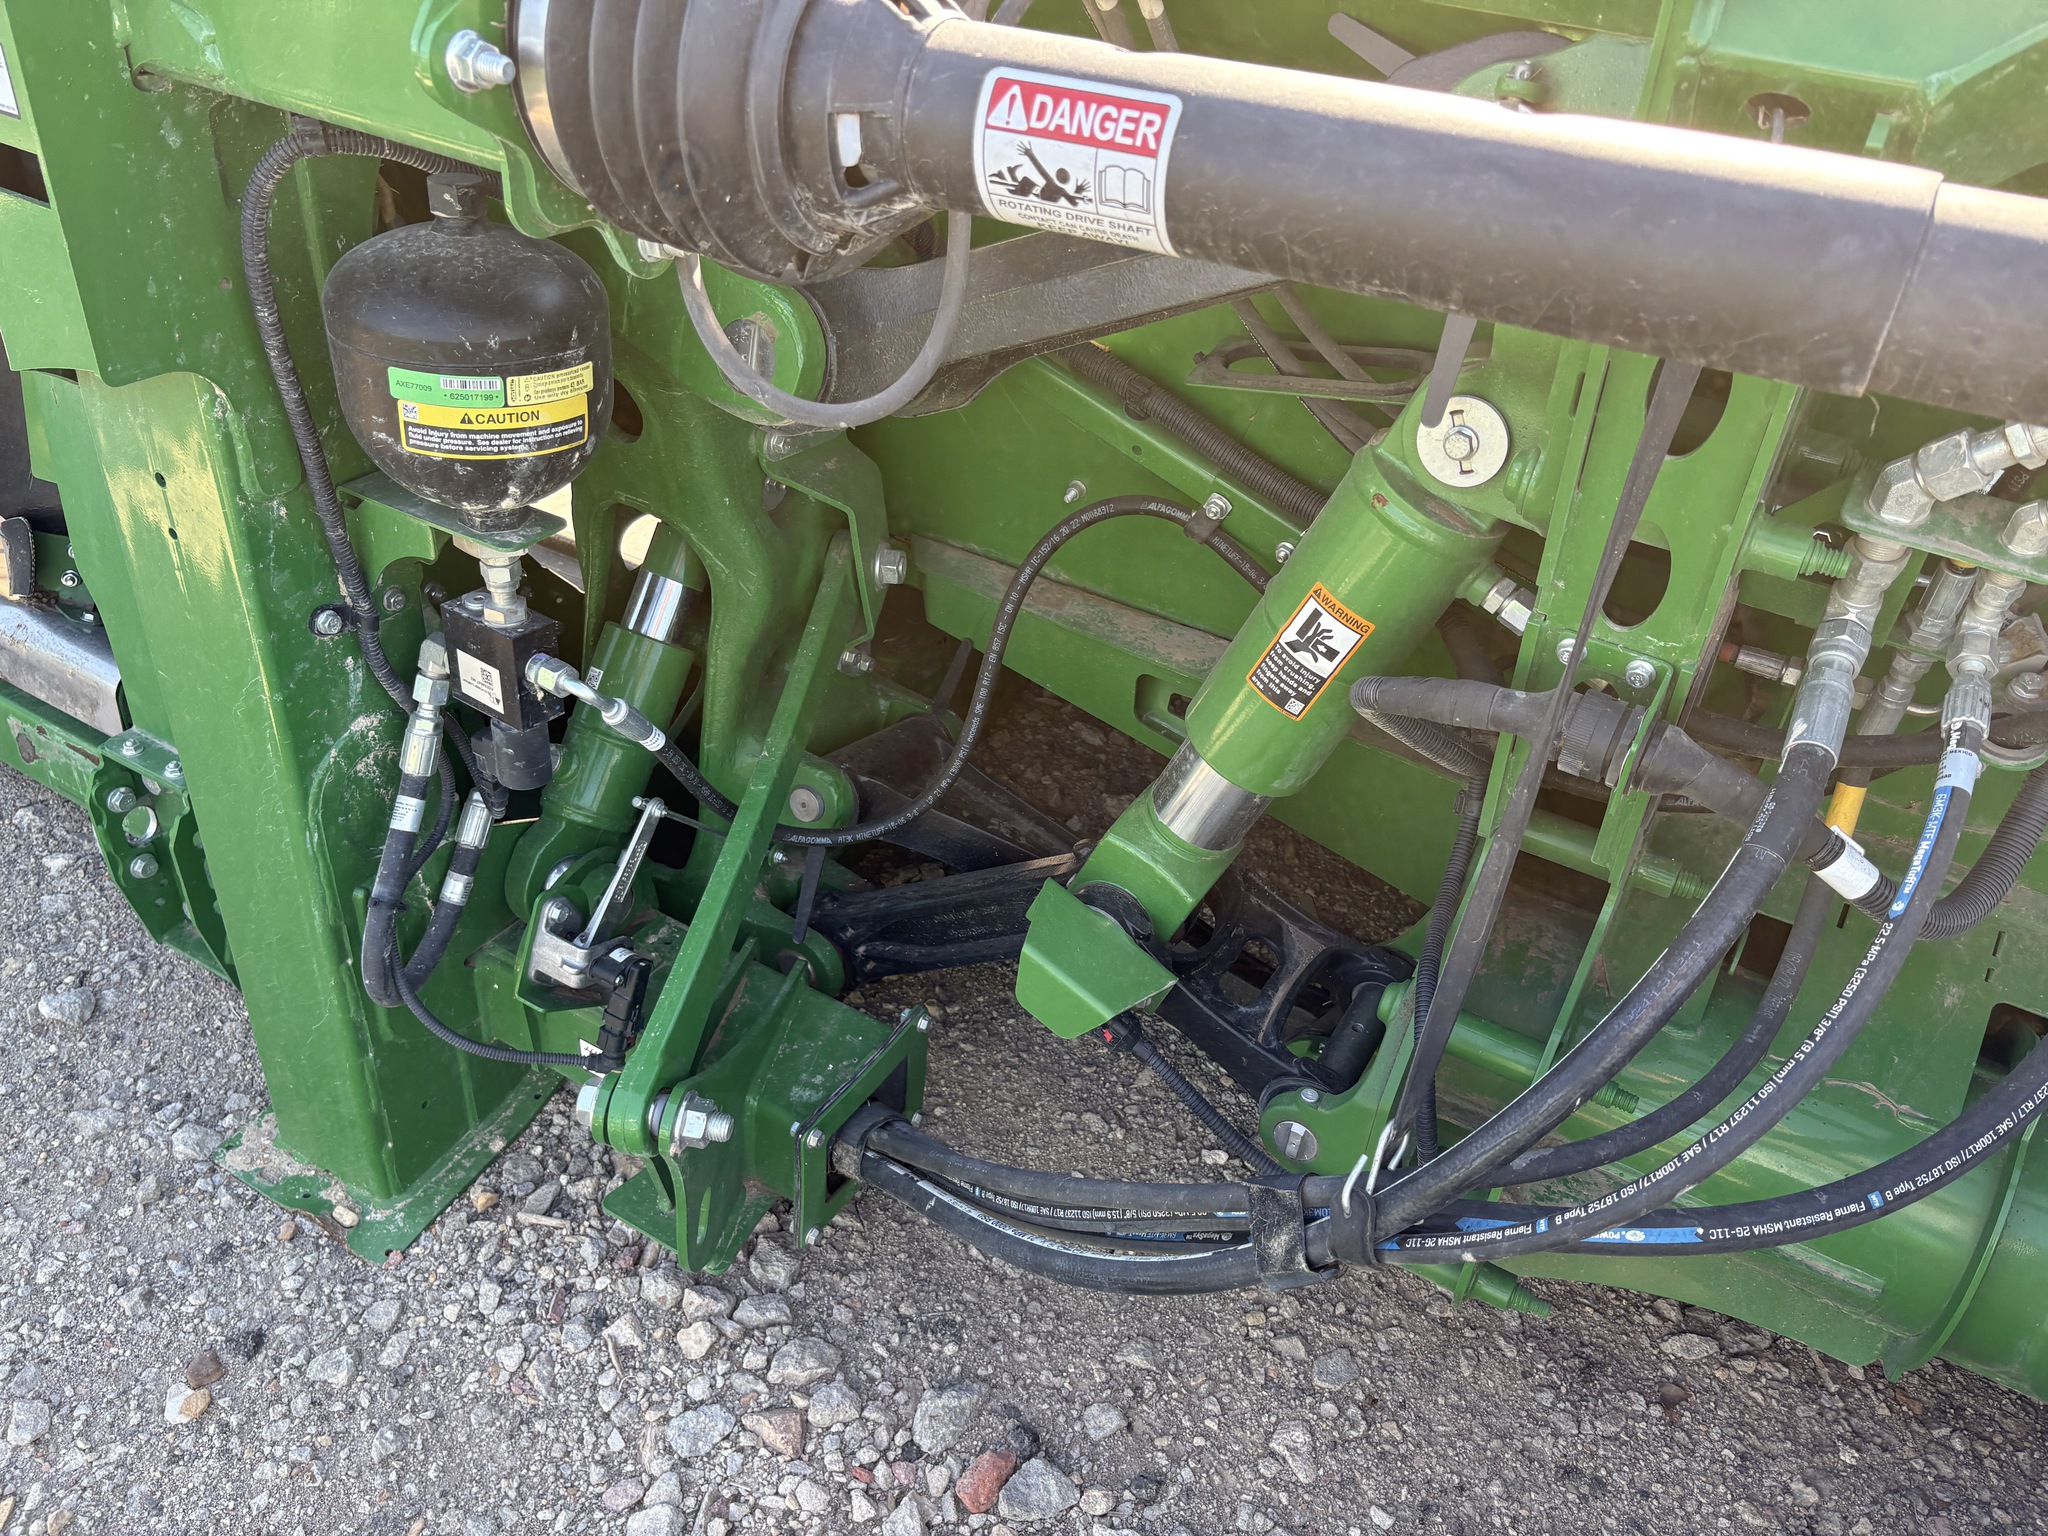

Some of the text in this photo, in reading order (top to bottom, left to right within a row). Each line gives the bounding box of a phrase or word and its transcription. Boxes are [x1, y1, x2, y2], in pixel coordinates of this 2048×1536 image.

[1030, 93, 1162, 150] DANGER
[998, 199, 1152, 237] ROTATING DRIVE SHAFT
[1018, 212, 1139, 242] CONTACT CAN CAUSE DEATH
[1036, 223, 1130, 245] KEEP AWAY!
[395, 380, 433, 392] AXE77009
[450, 393, 494, 401] 625017199
[475, 410, 540, 425] CAUTION
[408, 425, 427, 435] Avoid
[501, 430, 537, 439] movement
[551, 421, 576, 434] exposure
[408, 432, 422, 440] fluid
[423, 434, 442, 444] under
[443, 437, 474, 446] pressure.
[562, 425, 583, 437] relieving
[409, 438, 439, 449] pressure
[440, 443, 463, 452] before
[465, 444, 498, 453] servicing
[1019, 566, 1033, 584] MSHA
[1010, 592, 1019, 601] 10
[1005, 603, 1014, 614] DN
[1320, 594, 1370, 634] WARNING
[992, 638, 1002, 652] 857
[989, 653, 997, 663] EN
[1270, 650, 1283, 666] from
[1275, 644, 1321, 684] To avoid injury
[1251, 675, 1264, 691] area.
[1256, 669, 1281, 695] from this
[1260, 663, 1298, 697] fingers away
[1265, 656, 1313, 696] keep hands and
[979, 687, 989, 700] 100
[975, 702, 984, 714] SAE
[968, 717, 980, 742] exceeds
[950, 760, 962, 776] (3000
[941, 778, 952, 789] MPa
[1924, 792, 1947, 839] 6M3K-MTF
[789, 834, 832, 844] ALFAGOMMA
[1874, 922, 1894, 945] 22.5
[1861, 945, 1881, 966] MPa
[1842, 967, 1868, 998] (3250
[1825, 997, 1848, 1020] PSI)
[1813, 1017, 1832, 1042] 3/8"
[1796, 1039, 1815, 1064] (9.5
[1774, 1058, 1797, 1086] mm)
[1758, 1081, 1777, 1099] ISO
[1729, 1096, 1760, 1127] 11237
[2019, 1101, 2035, 1119] R17
[1710, 1123, 1730, 1143] R17
[1996, 1118, 2014, 1136] SAE
[1681, 1146, 1702, 1163] SAE
[1945, 1155, 1961, 1171] ISO
[1916, 1164, 1945, 1187] 18752
[960, 1180, 974, 1194] Flame
[981, 1190, 986, 1198] B
[1620, 1184, 1638, 1198] ISO
[1894, 1181, 1916, 1196] Type
[986, 1192, 998, 1204] Type
[996, 1195, 1010, 1208] 18752
[1587, 1193, 1619, 1213] 18752
[1885, 1190, 1893, 1201] B
[1010, 1200, 1019, 1210] ISO
[1038, 1205, 1050, 1217] SAE
[1563, 1205, 1587, 1221] Type
[1834, 1201, 1866, 1217] Flame
[1052, 1209, 1064, 1218] R17
[1064, 1209, 1081, 1219] 11237
[1081, 1209, 1092, 1219] ISO
[1092, 1210, 1106, 1219] mm)
[1106, 1210, 1123, 1220] (15.9
[1123, 1209, 1138, 1219] 5/8"
[1555, 1215, 1563, 1225] B
[1785, 1210, 1833, 1230] Resistant
[1503, 1223, 1533, 1237] Flame
[1709, 1225, 1750, 1240] 2G-11C
[1752, 1221, 1783, 1236] MSHA
[1406, 1238, 1436, 1248] 2G-11C
[1437, 1236, 1462, 1247] MSHA
[1462, 1230, 1503, 1244] Resistant
